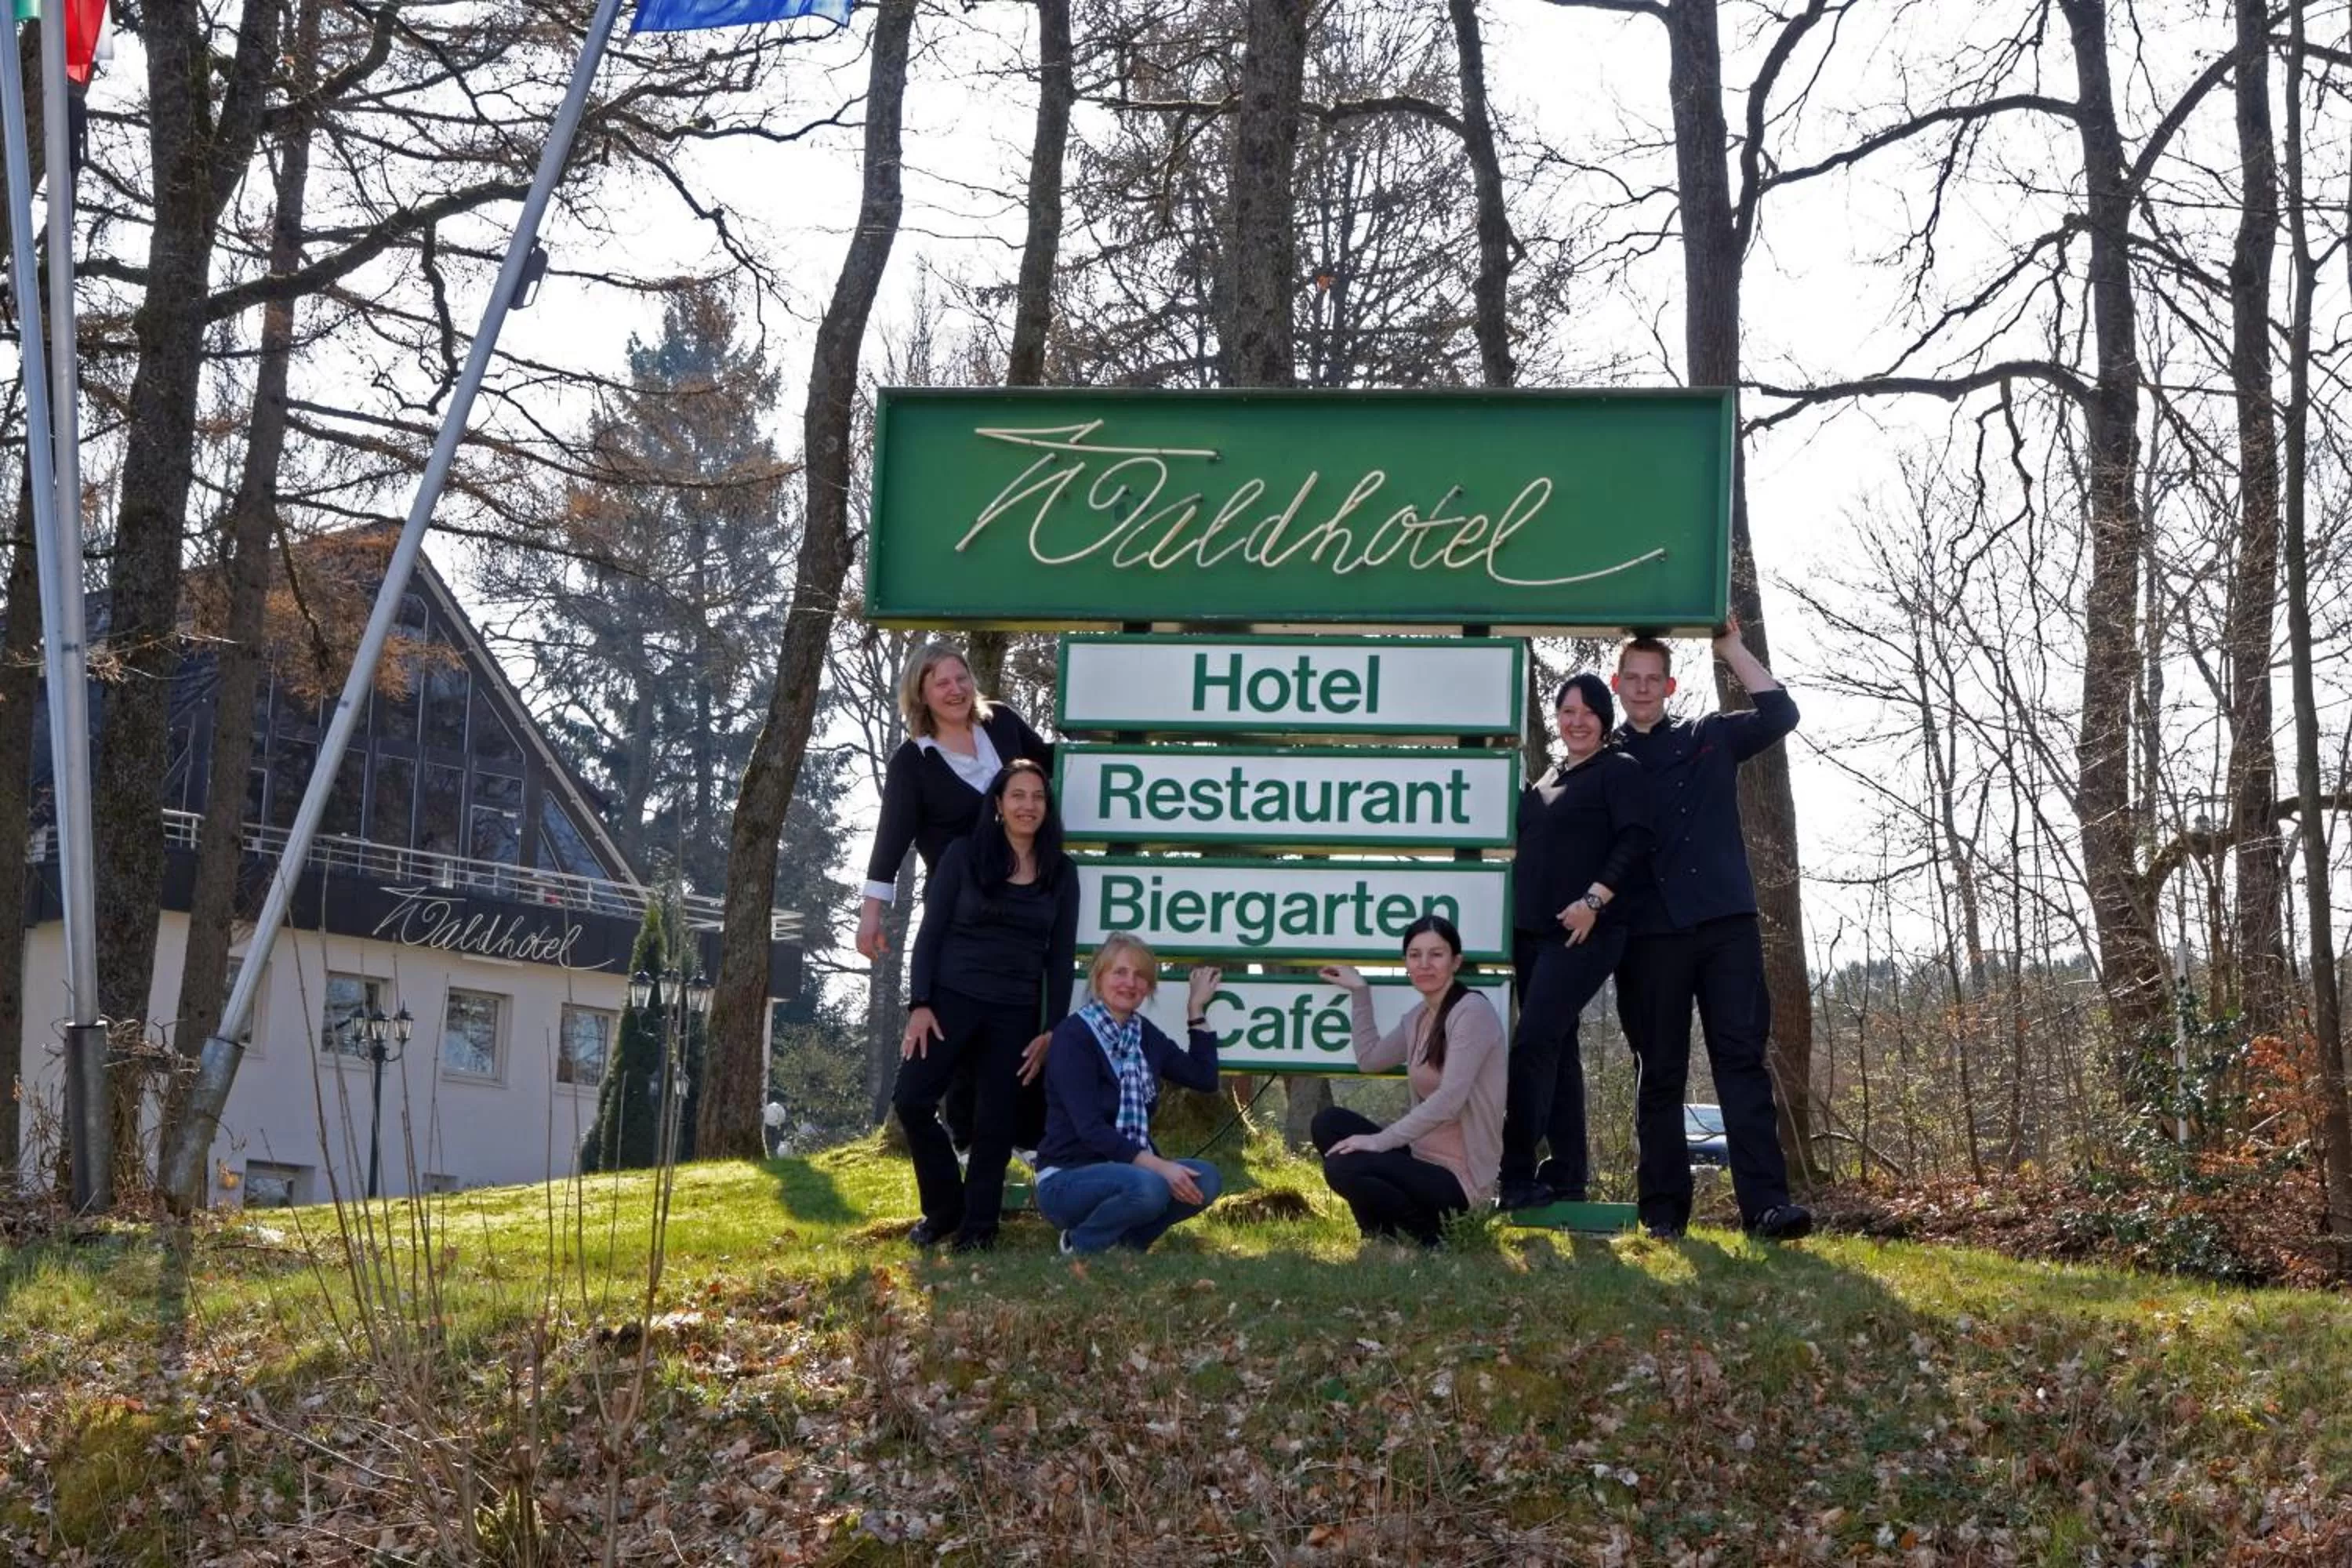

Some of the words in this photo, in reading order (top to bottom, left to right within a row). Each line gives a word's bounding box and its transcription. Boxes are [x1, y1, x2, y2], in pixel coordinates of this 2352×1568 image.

[955, 419, 1667, 586] Waldhotel
[1192, 652, 1380, 713] Hotel
[1098, 763, 1470, 824] Restaurant
[372, 886, 615, 970] Waldhotel
[1099, 874, 1459, 946] Biergarten
[1203, 990, 1351, 1051] Café
